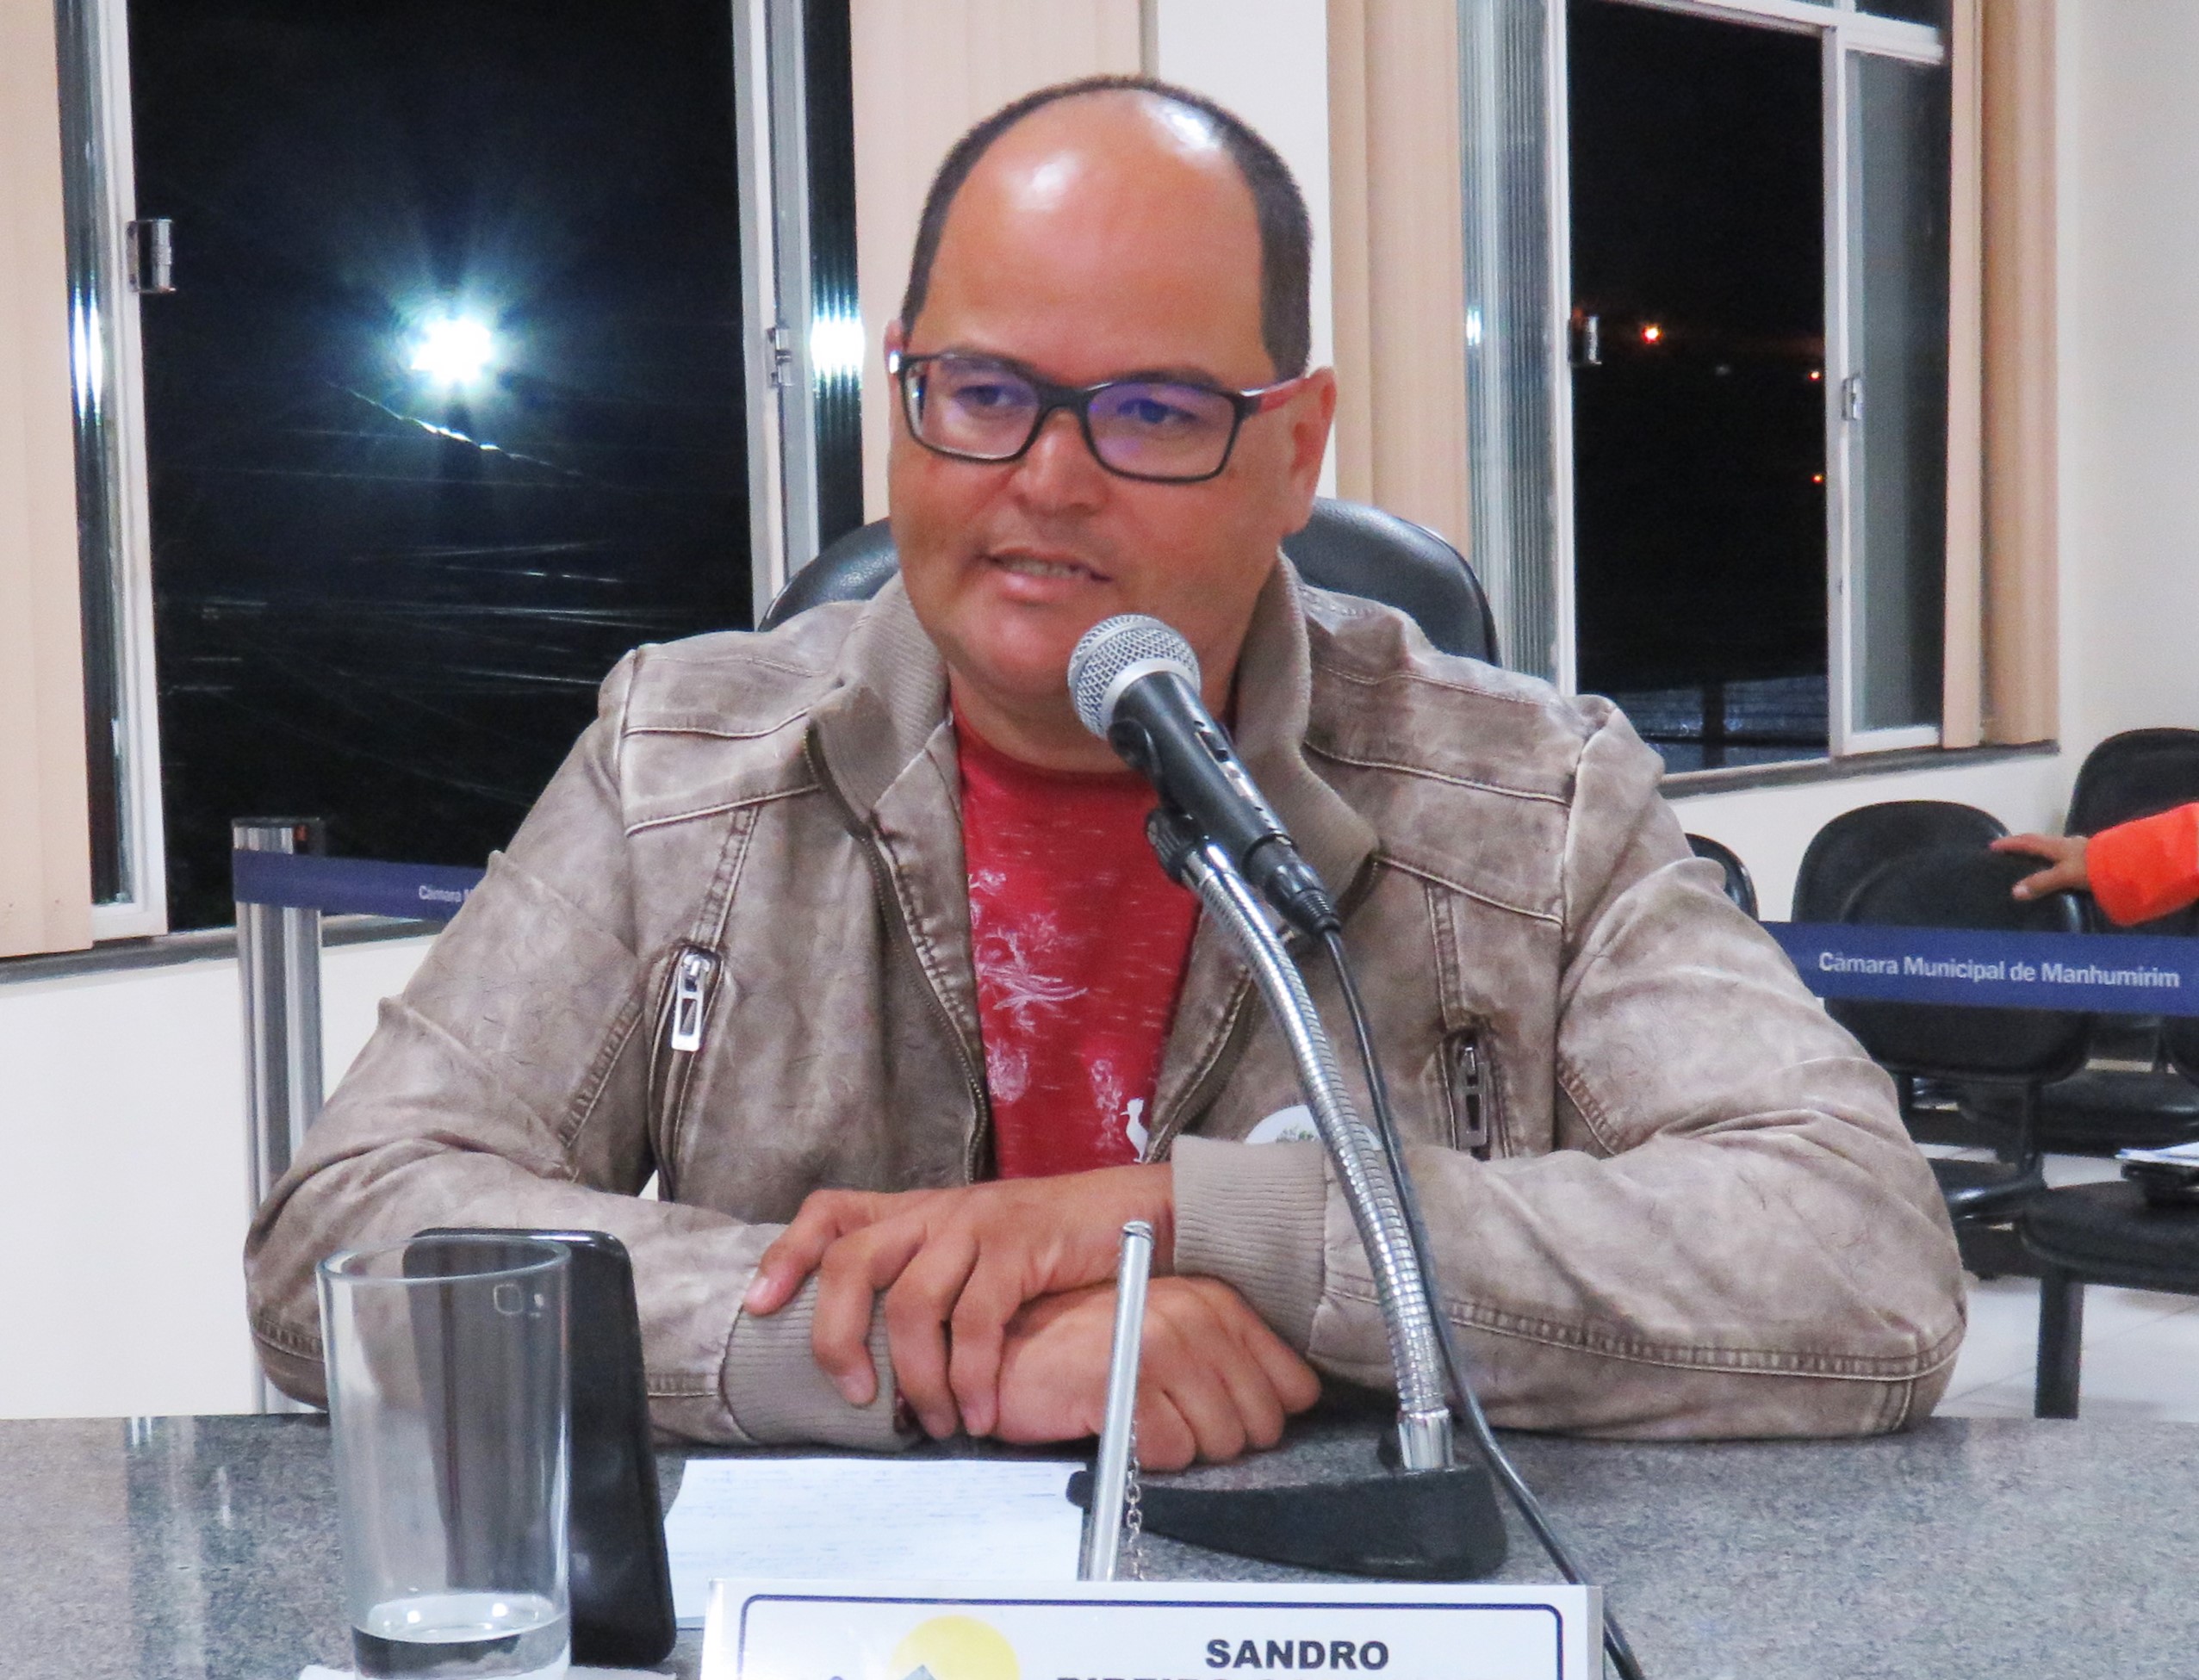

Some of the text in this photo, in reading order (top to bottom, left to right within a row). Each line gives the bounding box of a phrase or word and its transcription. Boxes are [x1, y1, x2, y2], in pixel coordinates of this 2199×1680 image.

[1818, 951, 2181, 988] Câmara Municipal de Manhumirim
[1205, 1639, 1389, 1671] SANDRO
